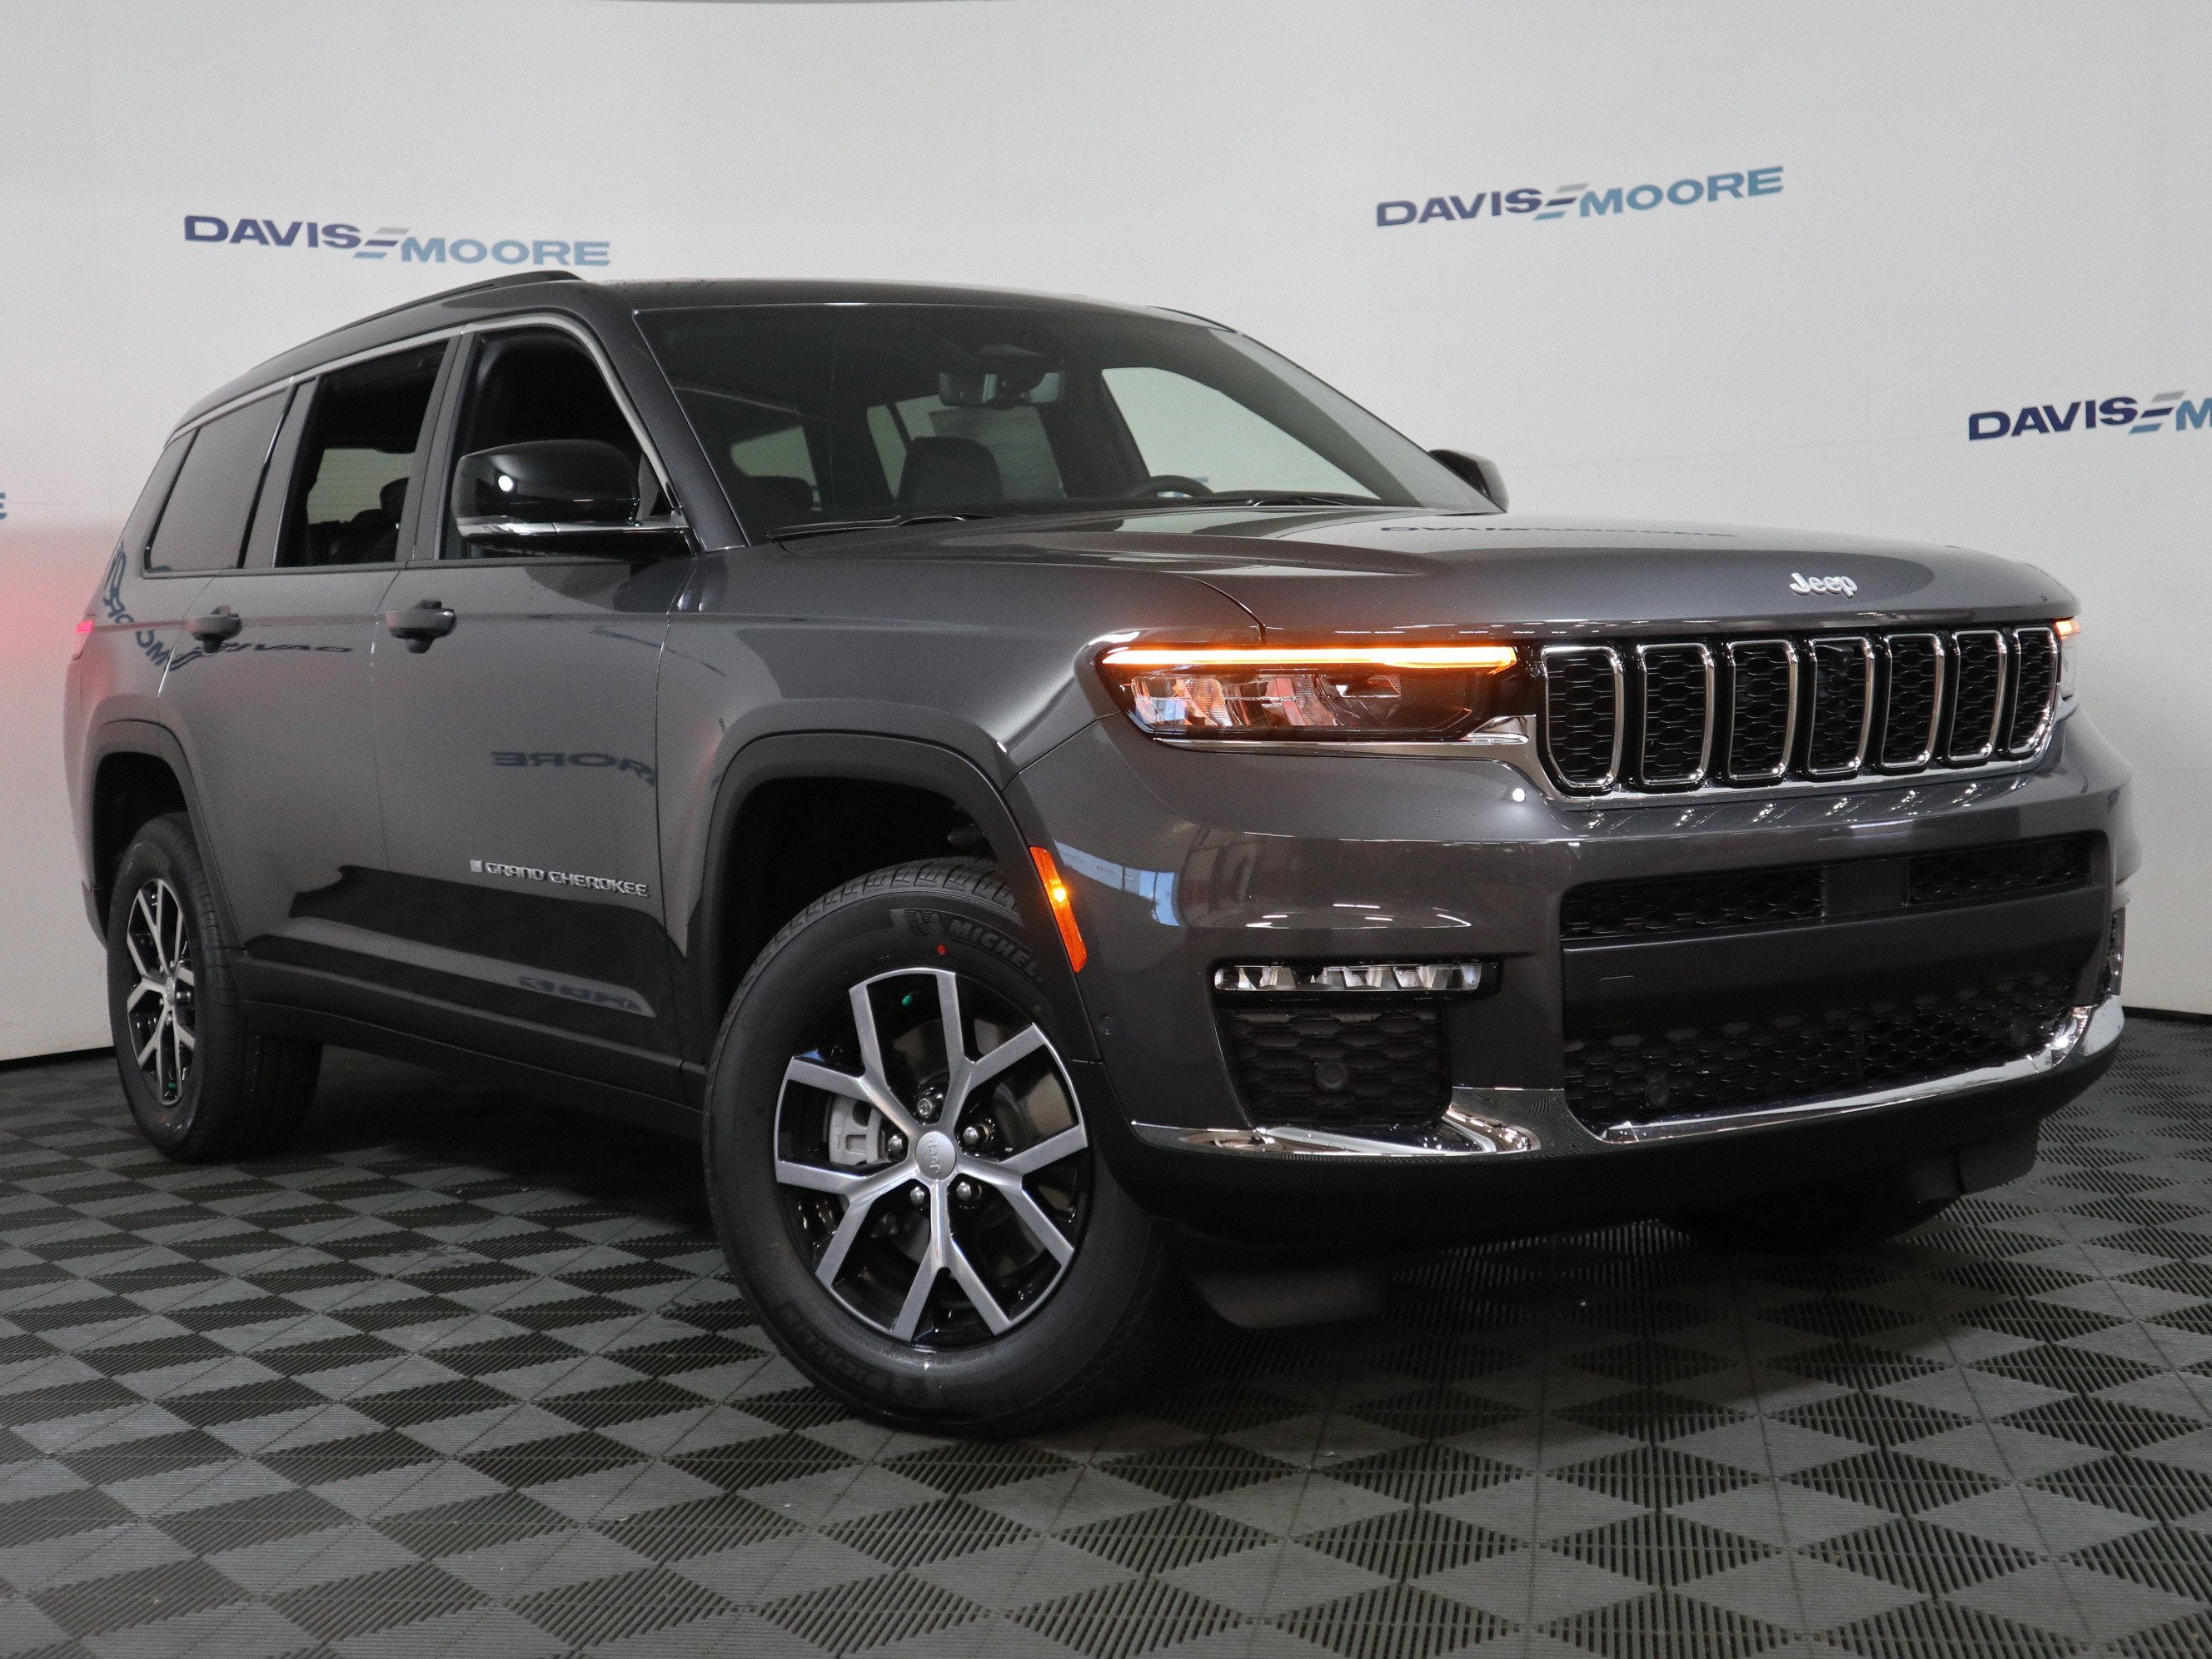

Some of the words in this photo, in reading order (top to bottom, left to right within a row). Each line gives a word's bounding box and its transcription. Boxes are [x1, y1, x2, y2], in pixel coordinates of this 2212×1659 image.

[1377, 187, 1542, 227] DAVIS
[1579, 166, 1784, 218] MOORE
[184, 215, 362, 249] DAVIS
[401, 237, 610, 267] MOORE
[1969, 396, 2139, 441] DAVIS
[1790, 572, 1858, 598] Jeep
[485, 862, 546, 882] GRAND
[547, 871, 650, 898] CHEROKEE
[947, 919, 1044, 984] MICHEL
